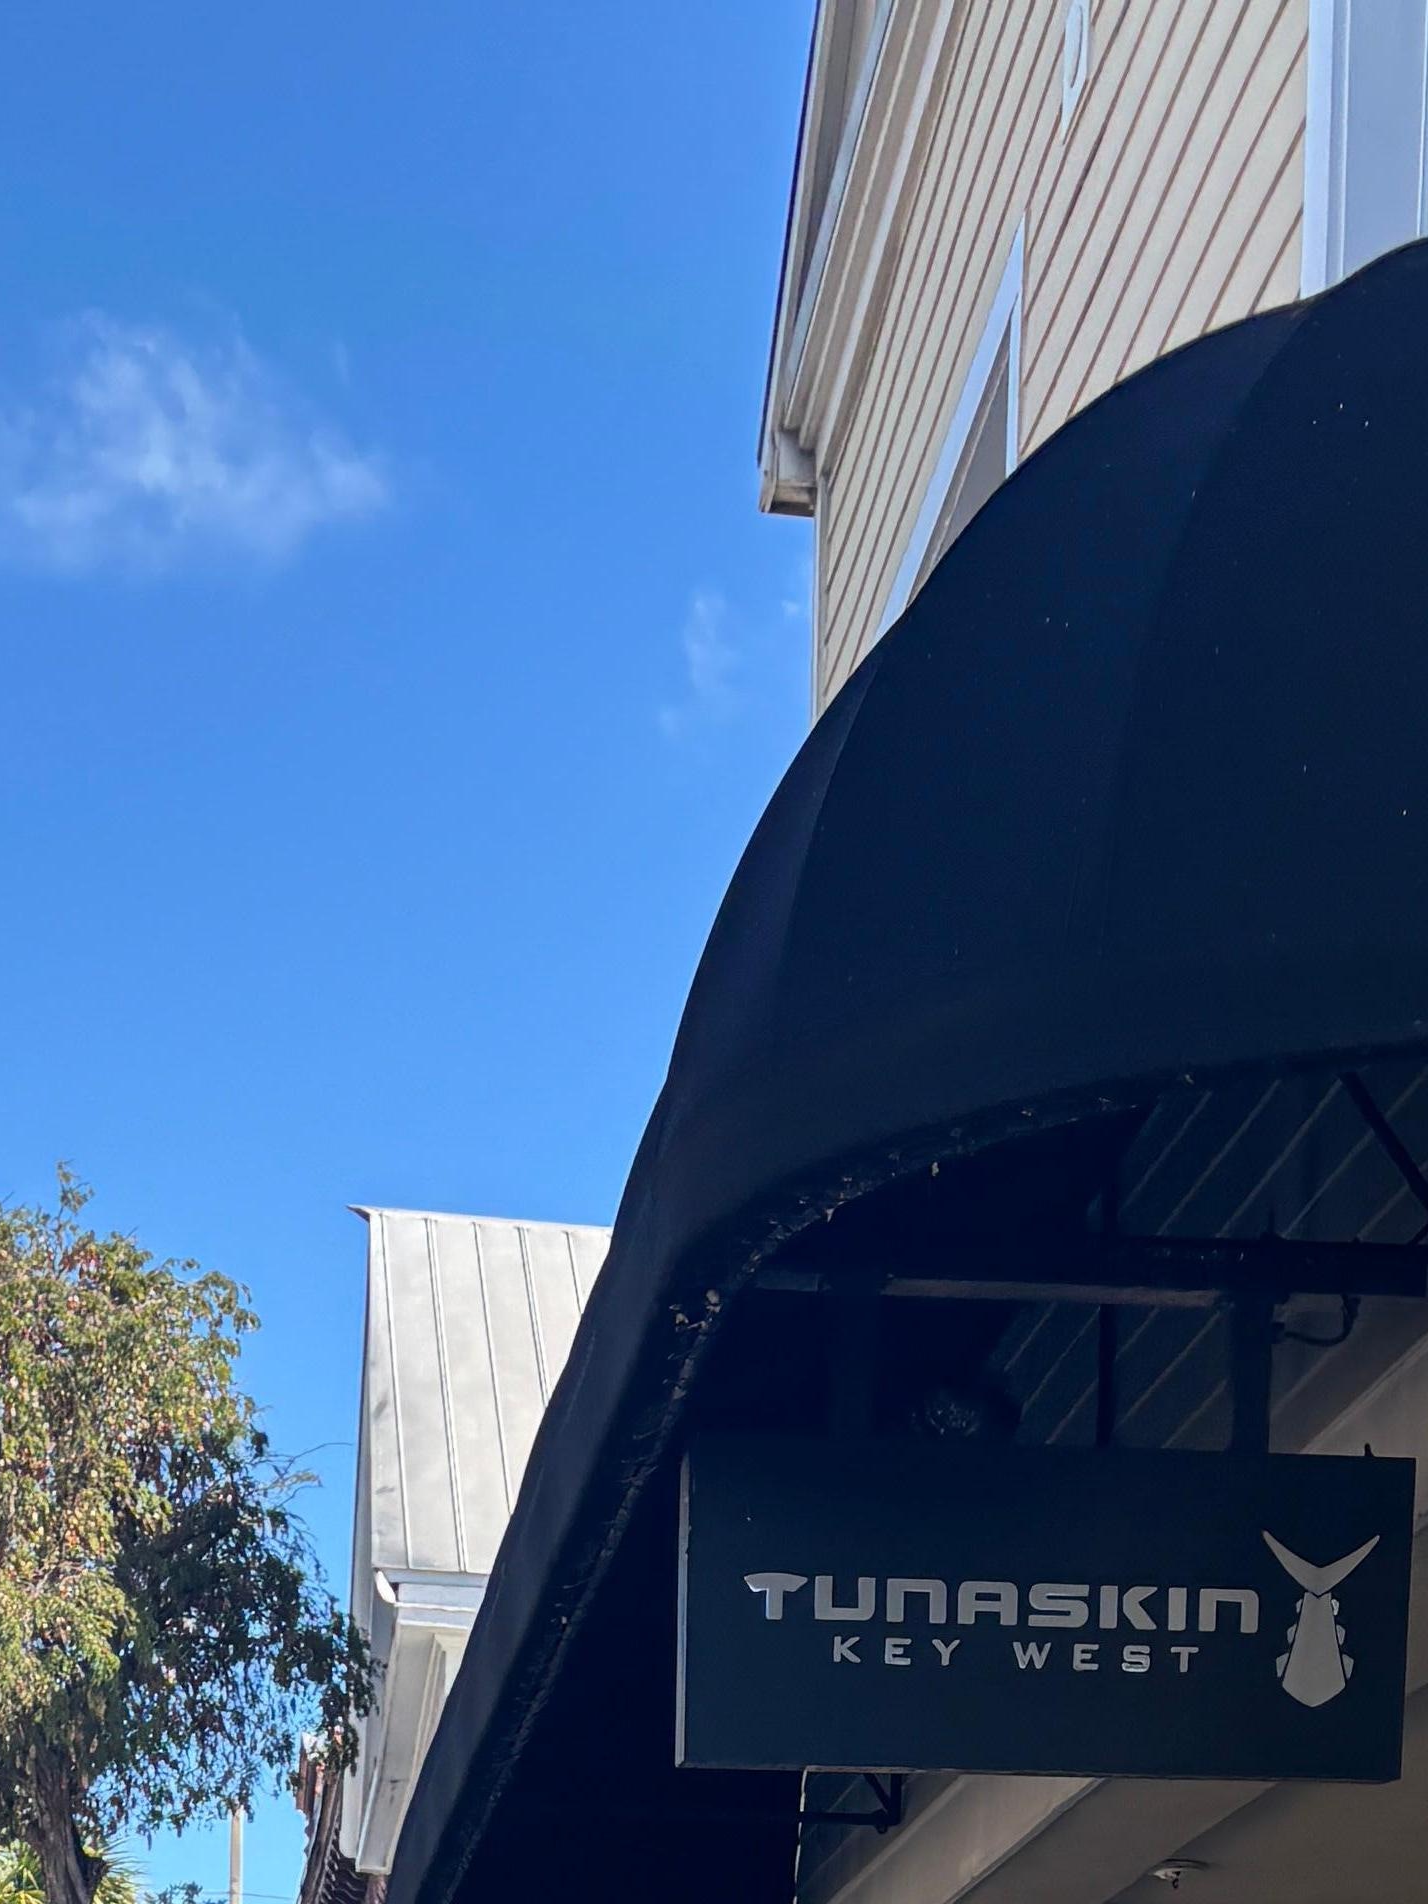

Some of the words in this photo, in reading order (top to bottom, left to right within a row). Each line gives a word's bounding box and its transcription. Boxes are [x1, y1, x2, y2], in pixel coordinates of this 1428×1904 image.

[743, 1572, 1260, 1634] TUNASKIN
[832, 1635, 961, 1666] KEY
[1012, 1640, 1200, 1673] WEST
